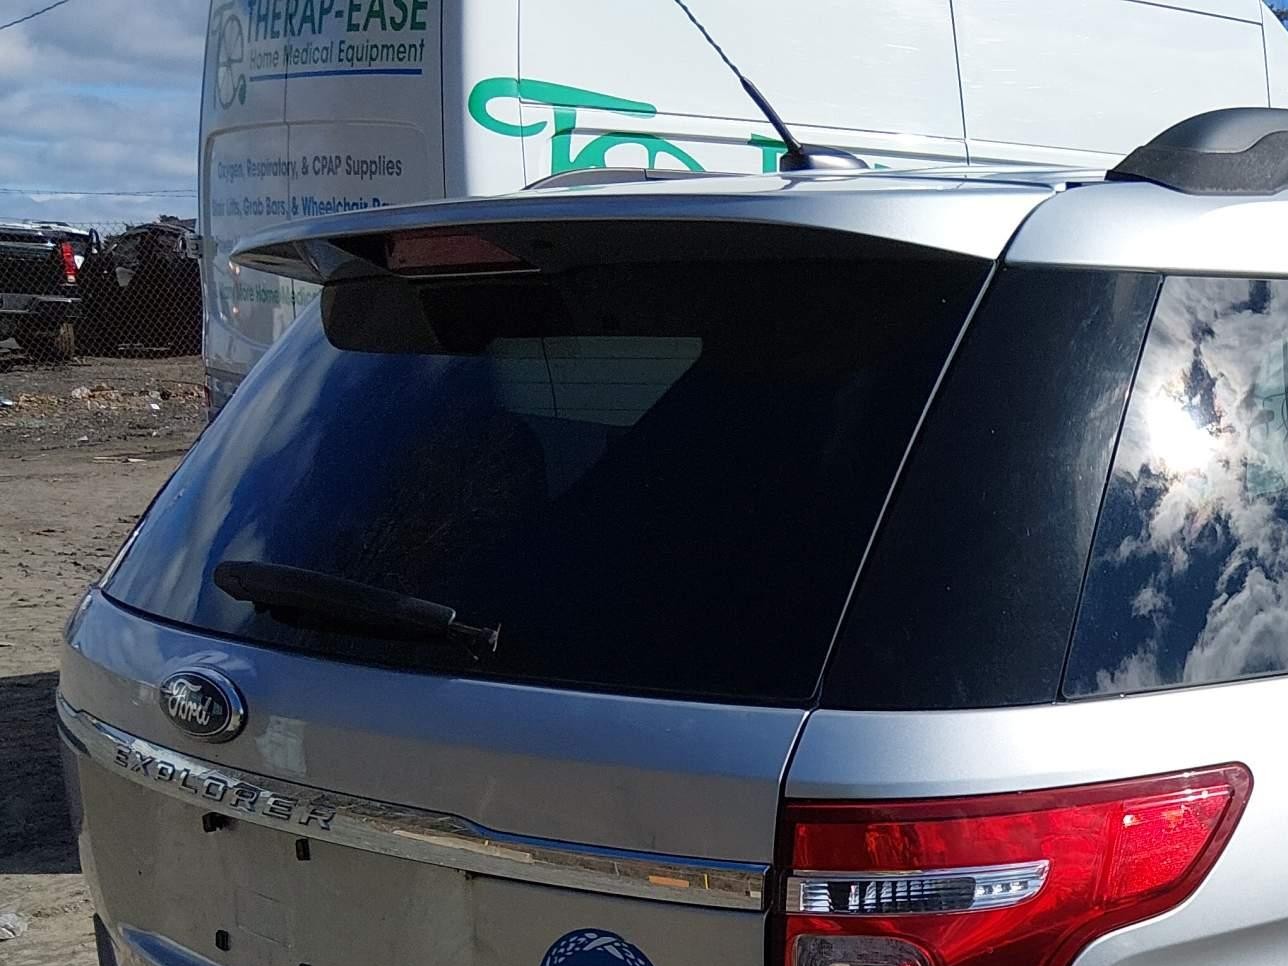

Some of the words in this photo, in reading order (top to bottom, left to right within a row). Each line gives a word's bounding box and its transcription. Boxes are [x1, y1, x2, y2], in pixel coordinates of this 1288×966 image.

[247, 0, 429, 43] THERAP-EASE
[250, 49, 279, 69] Home
[284, 41, 334, 66] Medical
[338, 38, 425, 67] Equipment
[301, 157, 309, 175] &
[312, 155, 342, 176] CPAP
[346, 154, 403, 180] Supplies
[291, 196, 299, 216] &
[167, 677, 212, 727] Ford
[113, 744, 338, 832] EXPLORER
